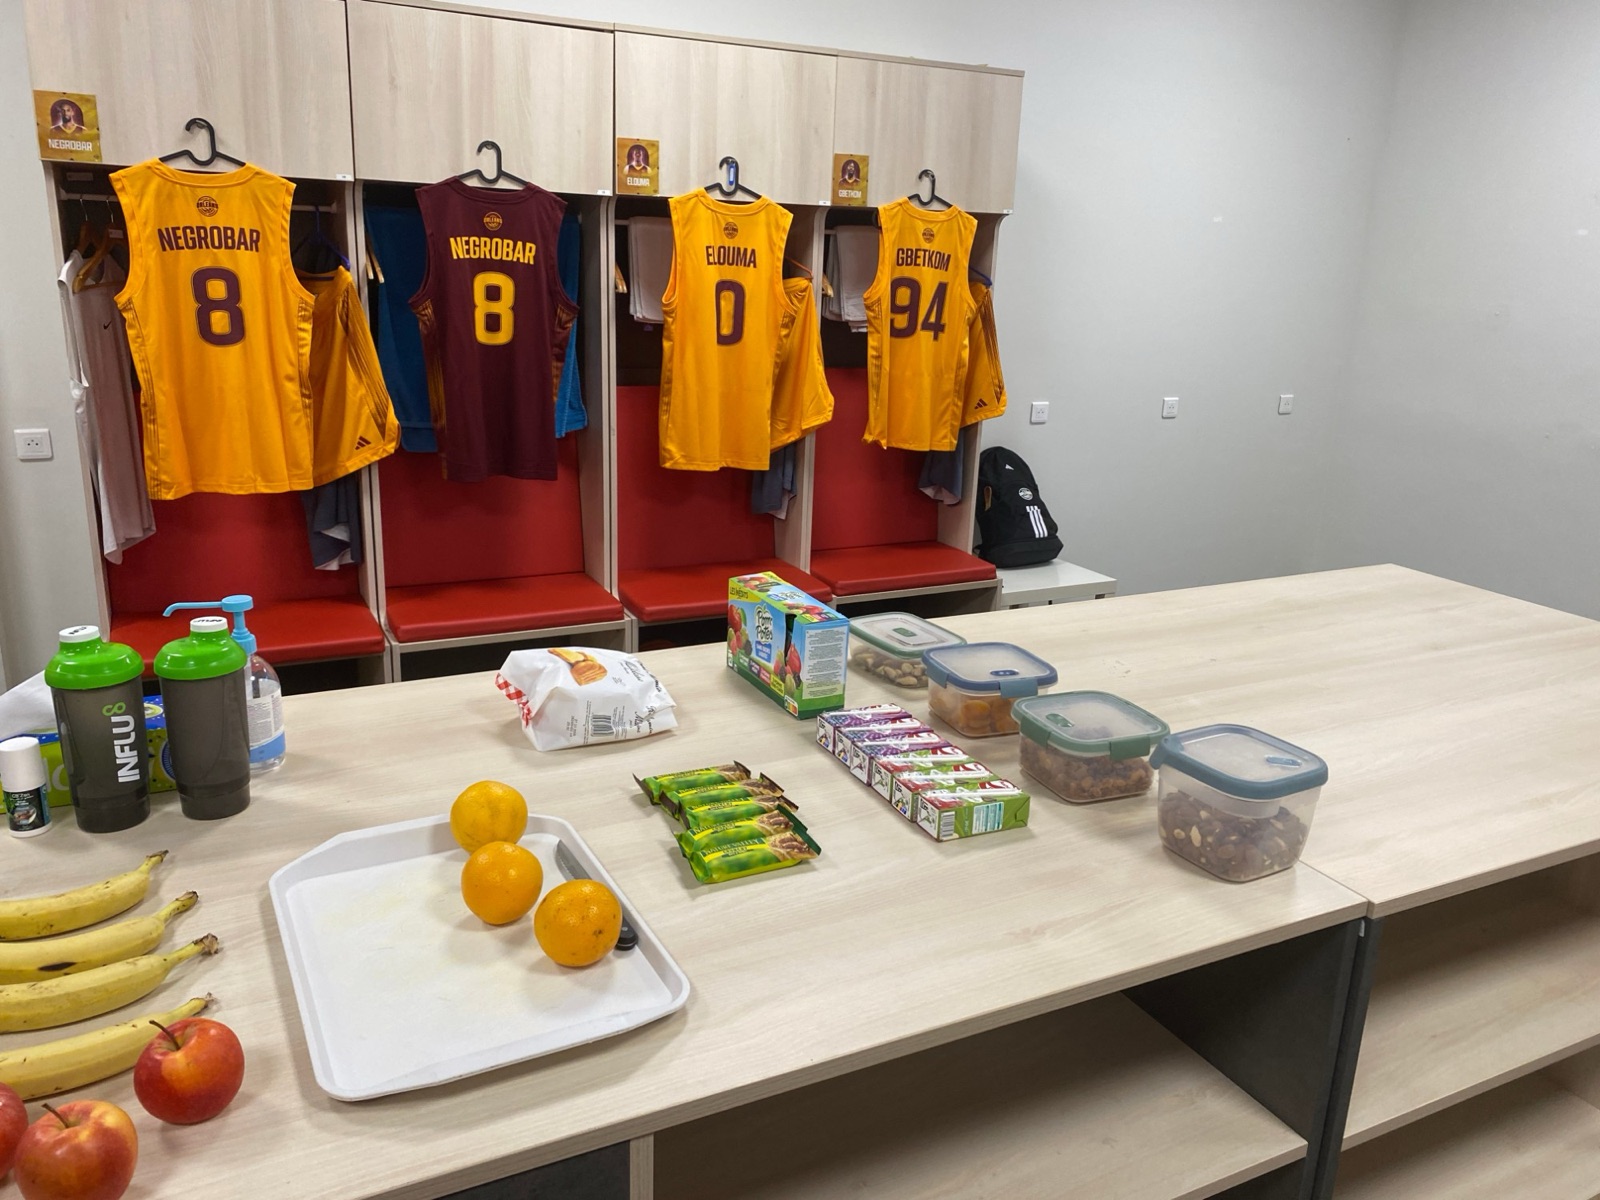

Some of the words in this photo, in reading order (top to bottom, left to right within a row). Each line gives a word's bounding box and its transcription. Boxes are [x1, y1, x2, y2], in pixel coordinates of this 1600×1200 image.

[48, 138, 93, 151] NEGROBAR
[626, 177, 650, 187] ELOUMA
[838, 189, 862, 199] GBETKOM
[157, 225, 261, 252] NEGROBAR
[449, 236, 536, 265] NEGROBAR
[705, 244, 757, 268] ELOUMA
[896, 247, 951, 272] GBETKOM
[191, 265, 245, 346] 8
[473, 271, 516, 346] 8
[890, 275, 948, 342] 94
